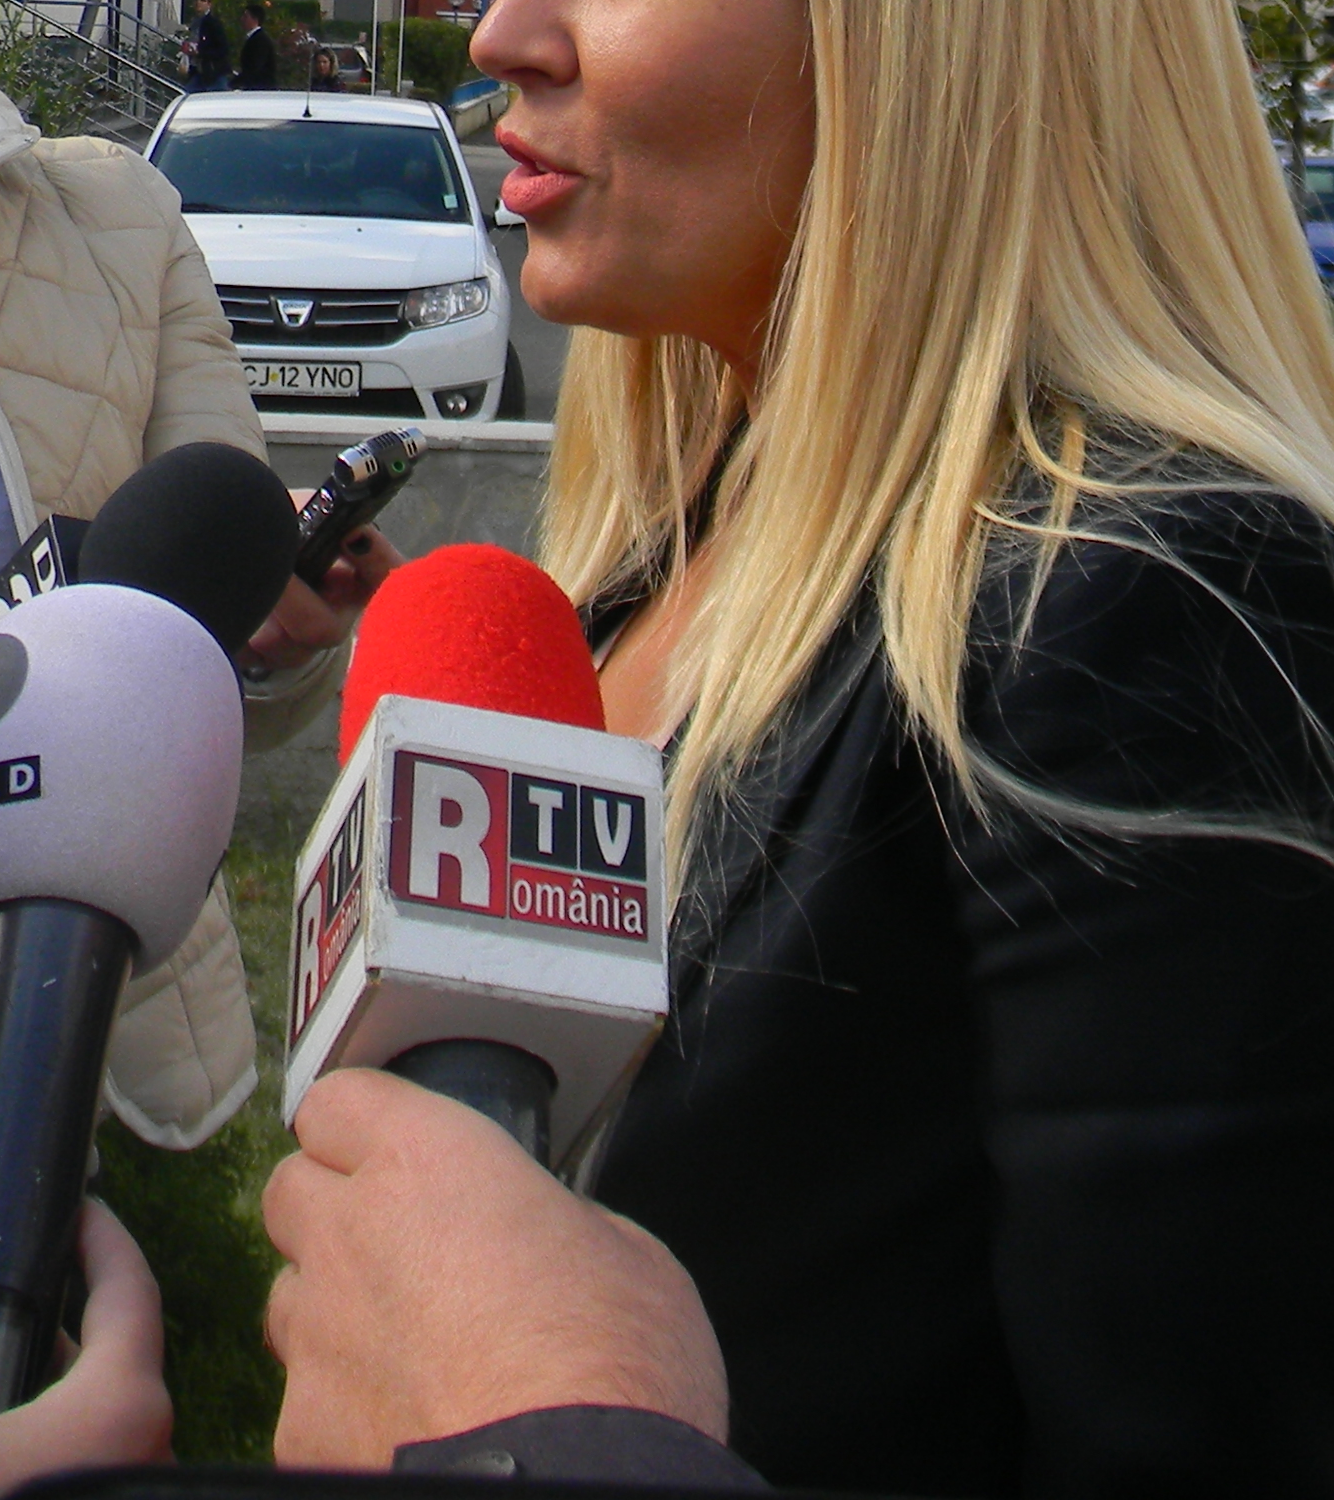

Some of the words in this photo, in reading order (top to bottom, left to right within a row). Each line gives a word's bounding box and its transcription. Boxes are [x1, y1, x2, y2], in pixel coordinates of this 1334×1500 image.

[279, 365, 300, 388] 12
[305, 366, 354, 389] YNO
[8, 762, 36, 796] D
